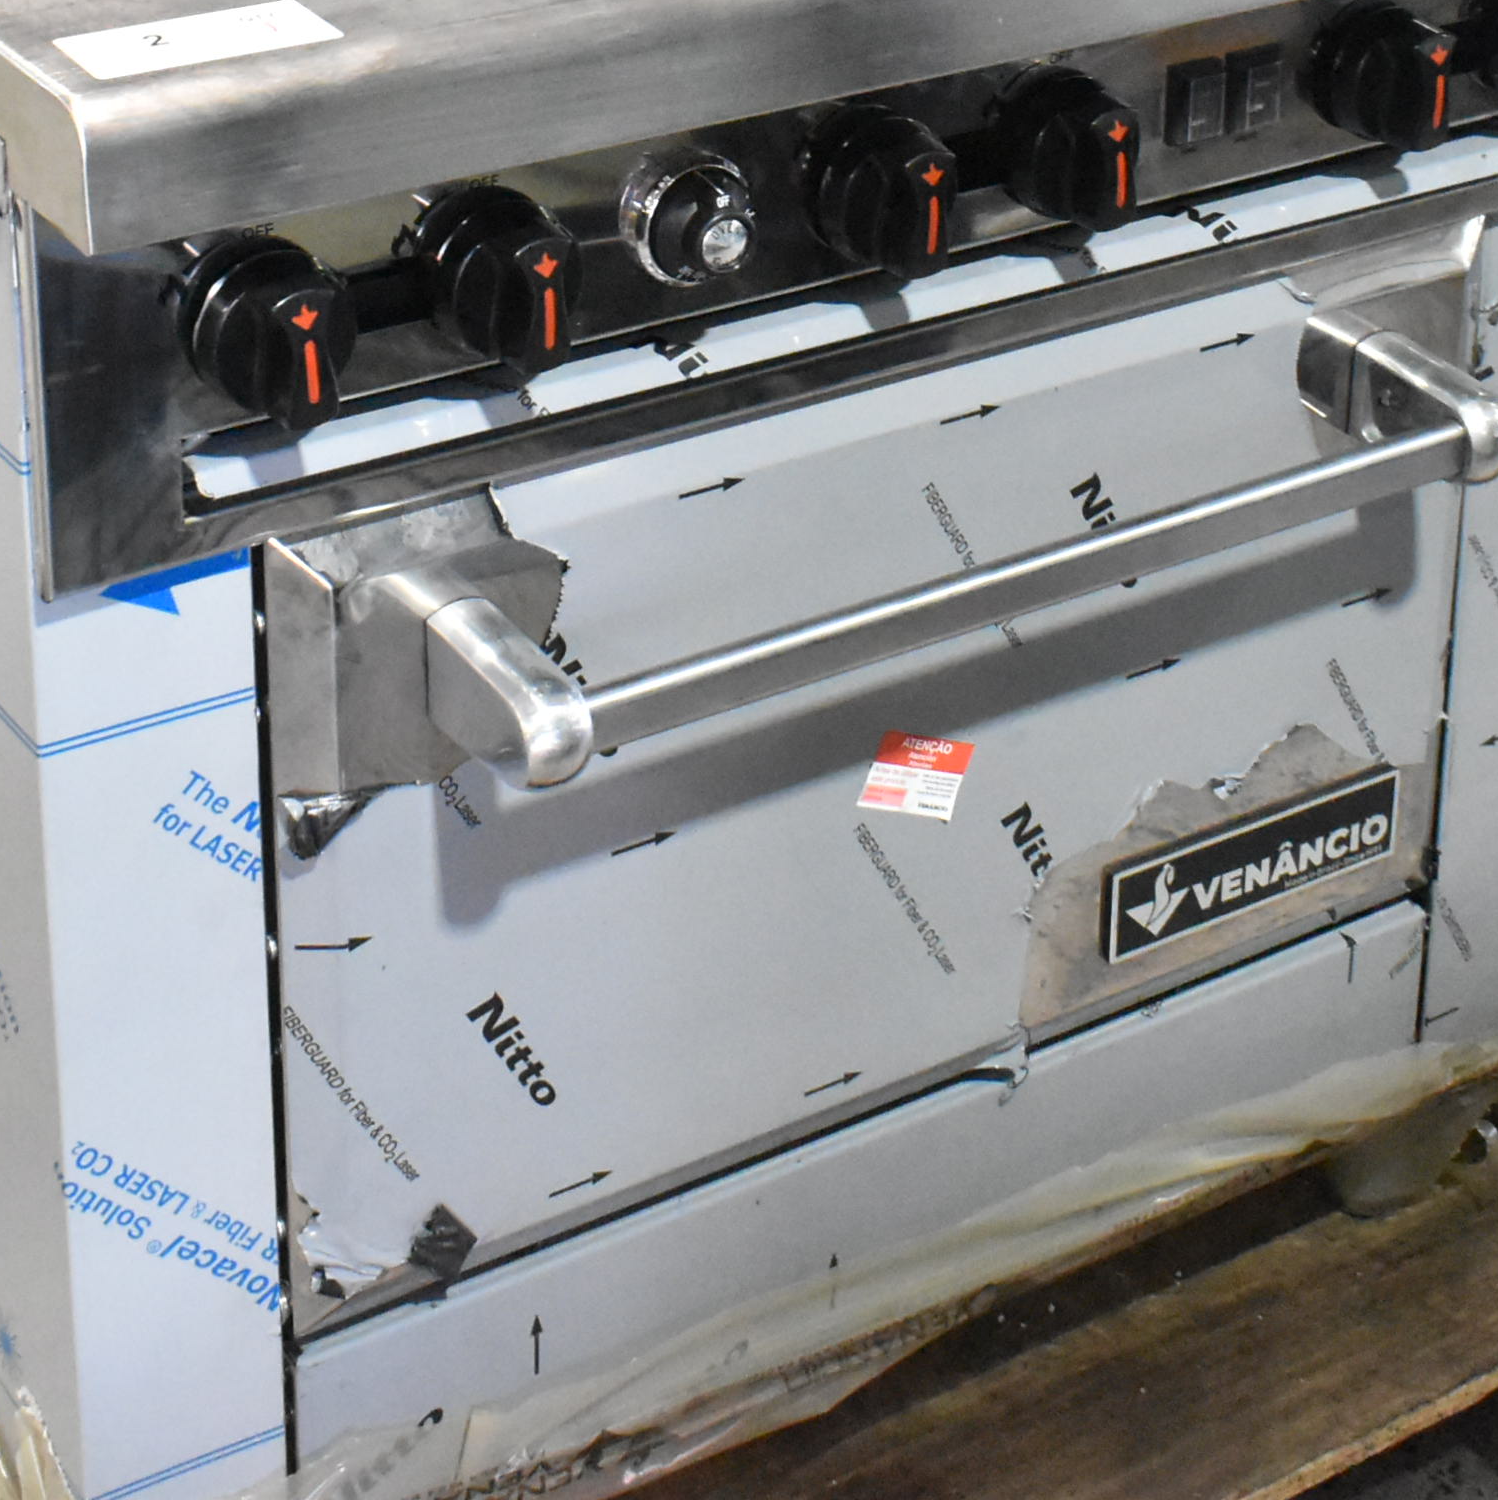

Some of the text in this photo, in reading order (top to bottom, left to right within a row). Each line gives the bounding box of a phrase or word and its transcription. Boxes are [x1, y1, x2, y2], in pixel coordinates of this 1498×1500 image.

[143, 34, 170, 46] 2
[241, 222, 275, 241] OFF
[181, 769, 230, 814] The
[152, 803, 192, 837] for
[189, 825, 264, 883] LASER
[854, 822, 901, 889] FIBERGUARD
[1000, 801, 1054, 878] Nit
[1191, 813, 1389, 911] VENÂNCIO
[465, 991, 557, 1107] Nitto
[283, 1004, 345, 1090] FIBERGUARD
[337, 1087, 356, 1107] for
[349, 1100, 377, 1131] Fiber
[369, 1124, 384, 1140] &
[394, 1151, 421, 1183] Laser
[113, 1163, 191, 1216] LASER
[190, 1199, 208, 1220] &
[204, 1209, 264, 1253] Fiber
